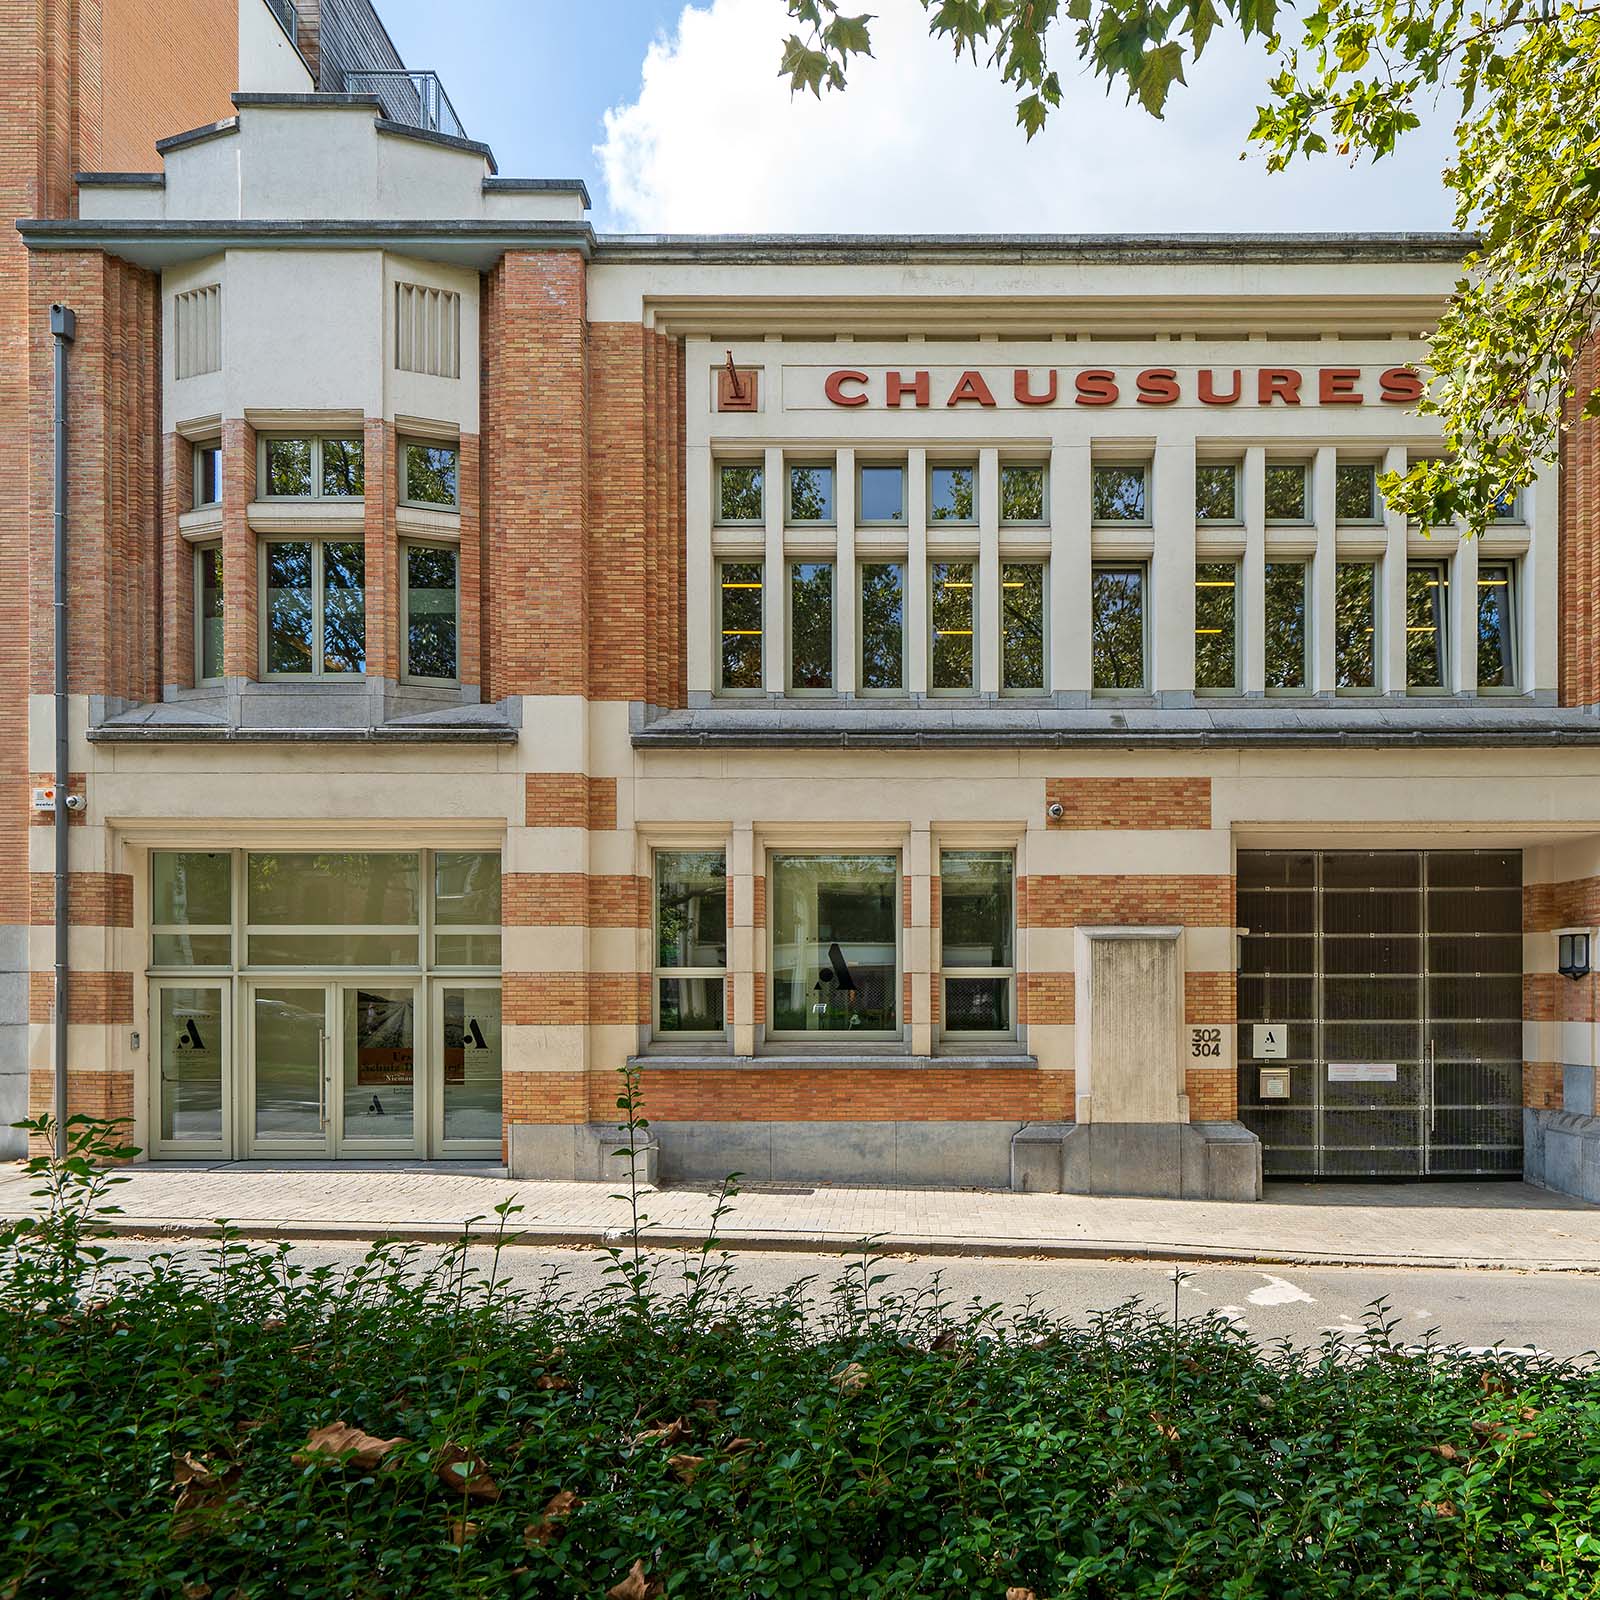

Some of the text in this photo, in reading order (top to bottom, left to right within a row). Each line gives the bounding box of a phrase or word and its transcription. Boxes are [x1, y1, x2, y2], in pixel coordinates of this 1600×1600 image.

[825, 368, 1425, 407] CHAUSSURES
[1192, 1028, 1222, 1042] 302
[1192, 1043, 1221, 1057] 304
